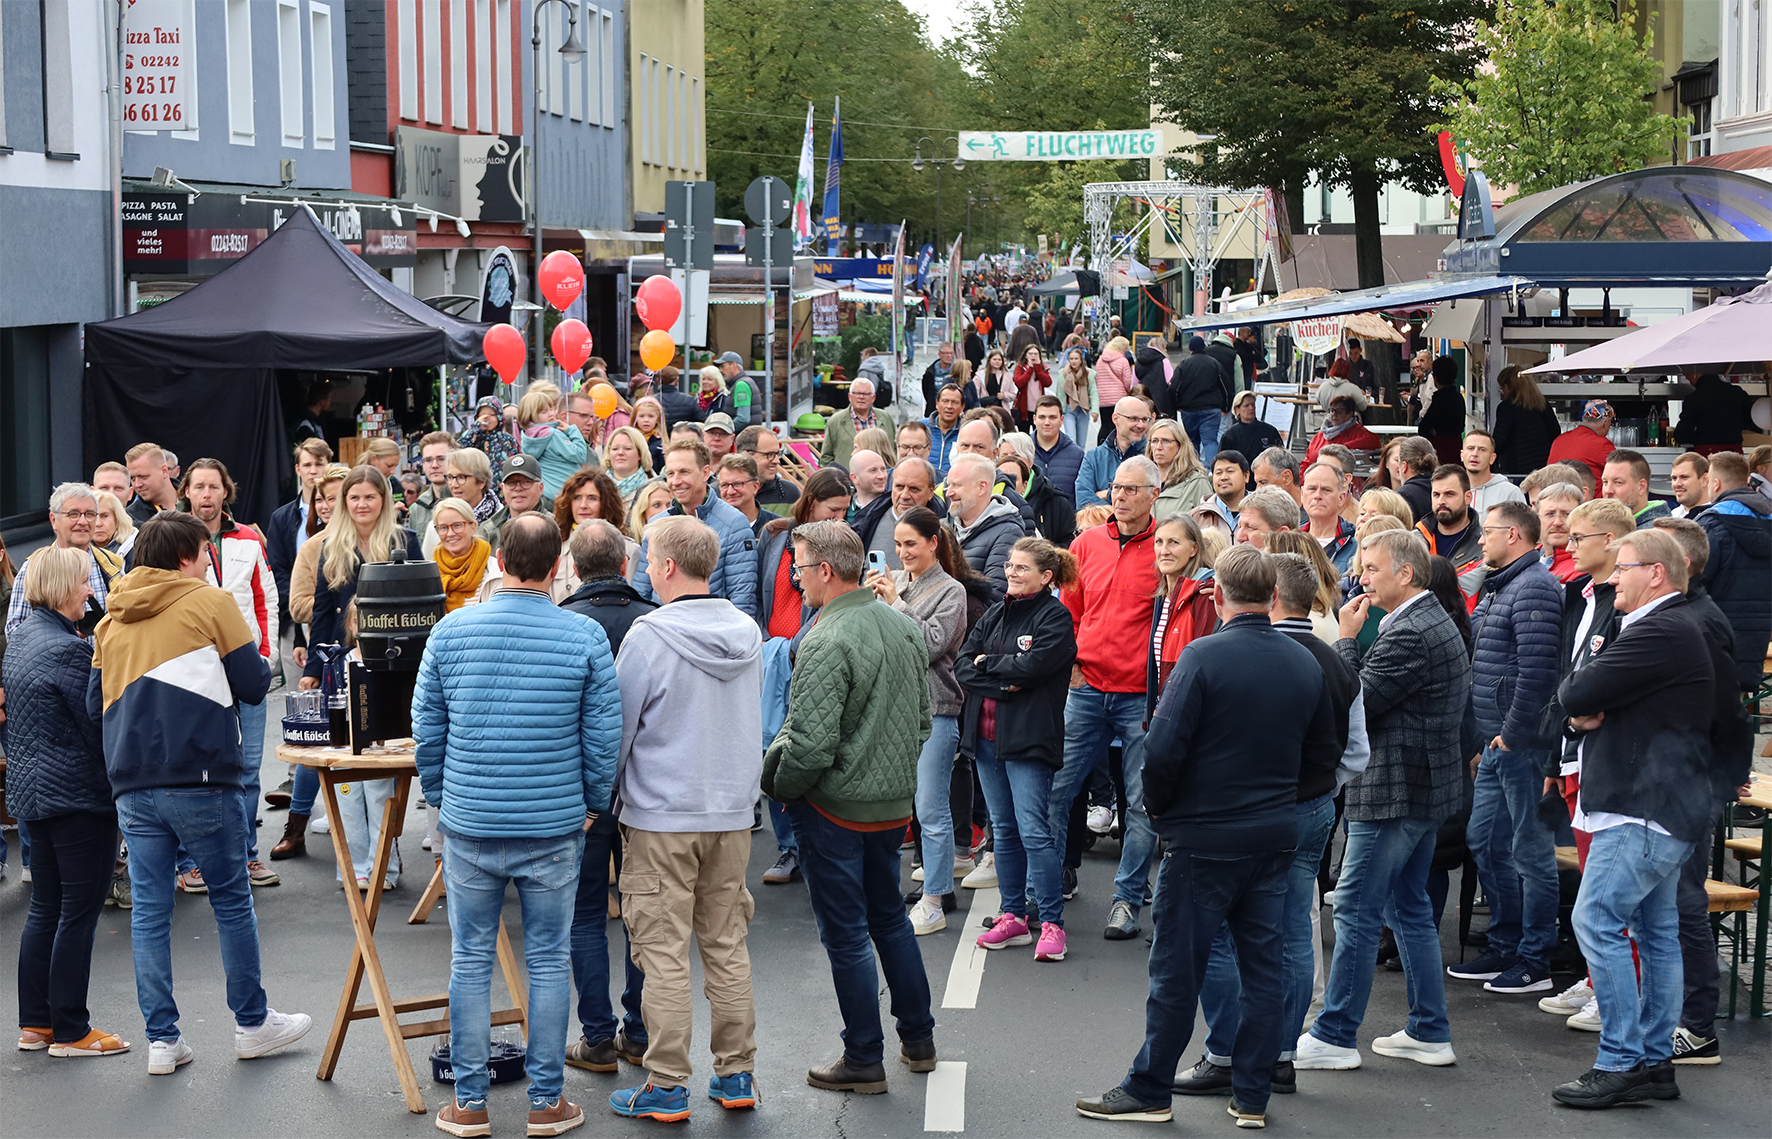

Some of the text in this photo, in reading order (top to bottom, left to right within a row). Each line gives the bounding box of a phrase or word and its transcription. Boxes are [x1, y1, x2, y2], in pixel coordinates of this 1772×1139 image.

[126, 27, 180, 44] izza Taxi
[141, 56, 179, 67] 02242
[136, 76, 155, 94] 25
[160, 76, 176, 94] 17
[141, 104, 158, 121] 61
[163, 104, 182, 121] 26
[1026, 133, 1155, 157] FLUCHTWEG
[463, 157, 507, 165] HAARSALON
[415, 144, 442, 196] KOPF
[121, 202, 177, 210] PIZZA PASTA
[121, 212, 184, 221] ASAGNE SALAT
[141, 229, 158, 237] und
[137, 238, 163, 246] vieles
[211, 234, 249, 253] 02242-82517
[137, 246, 162, 254] mehr!
[556, 281, 581, 290] KLEIN
[1297, 322, 1339, 338] kuchen
[367, 611, 437, 630] Gaffel Kölsch
